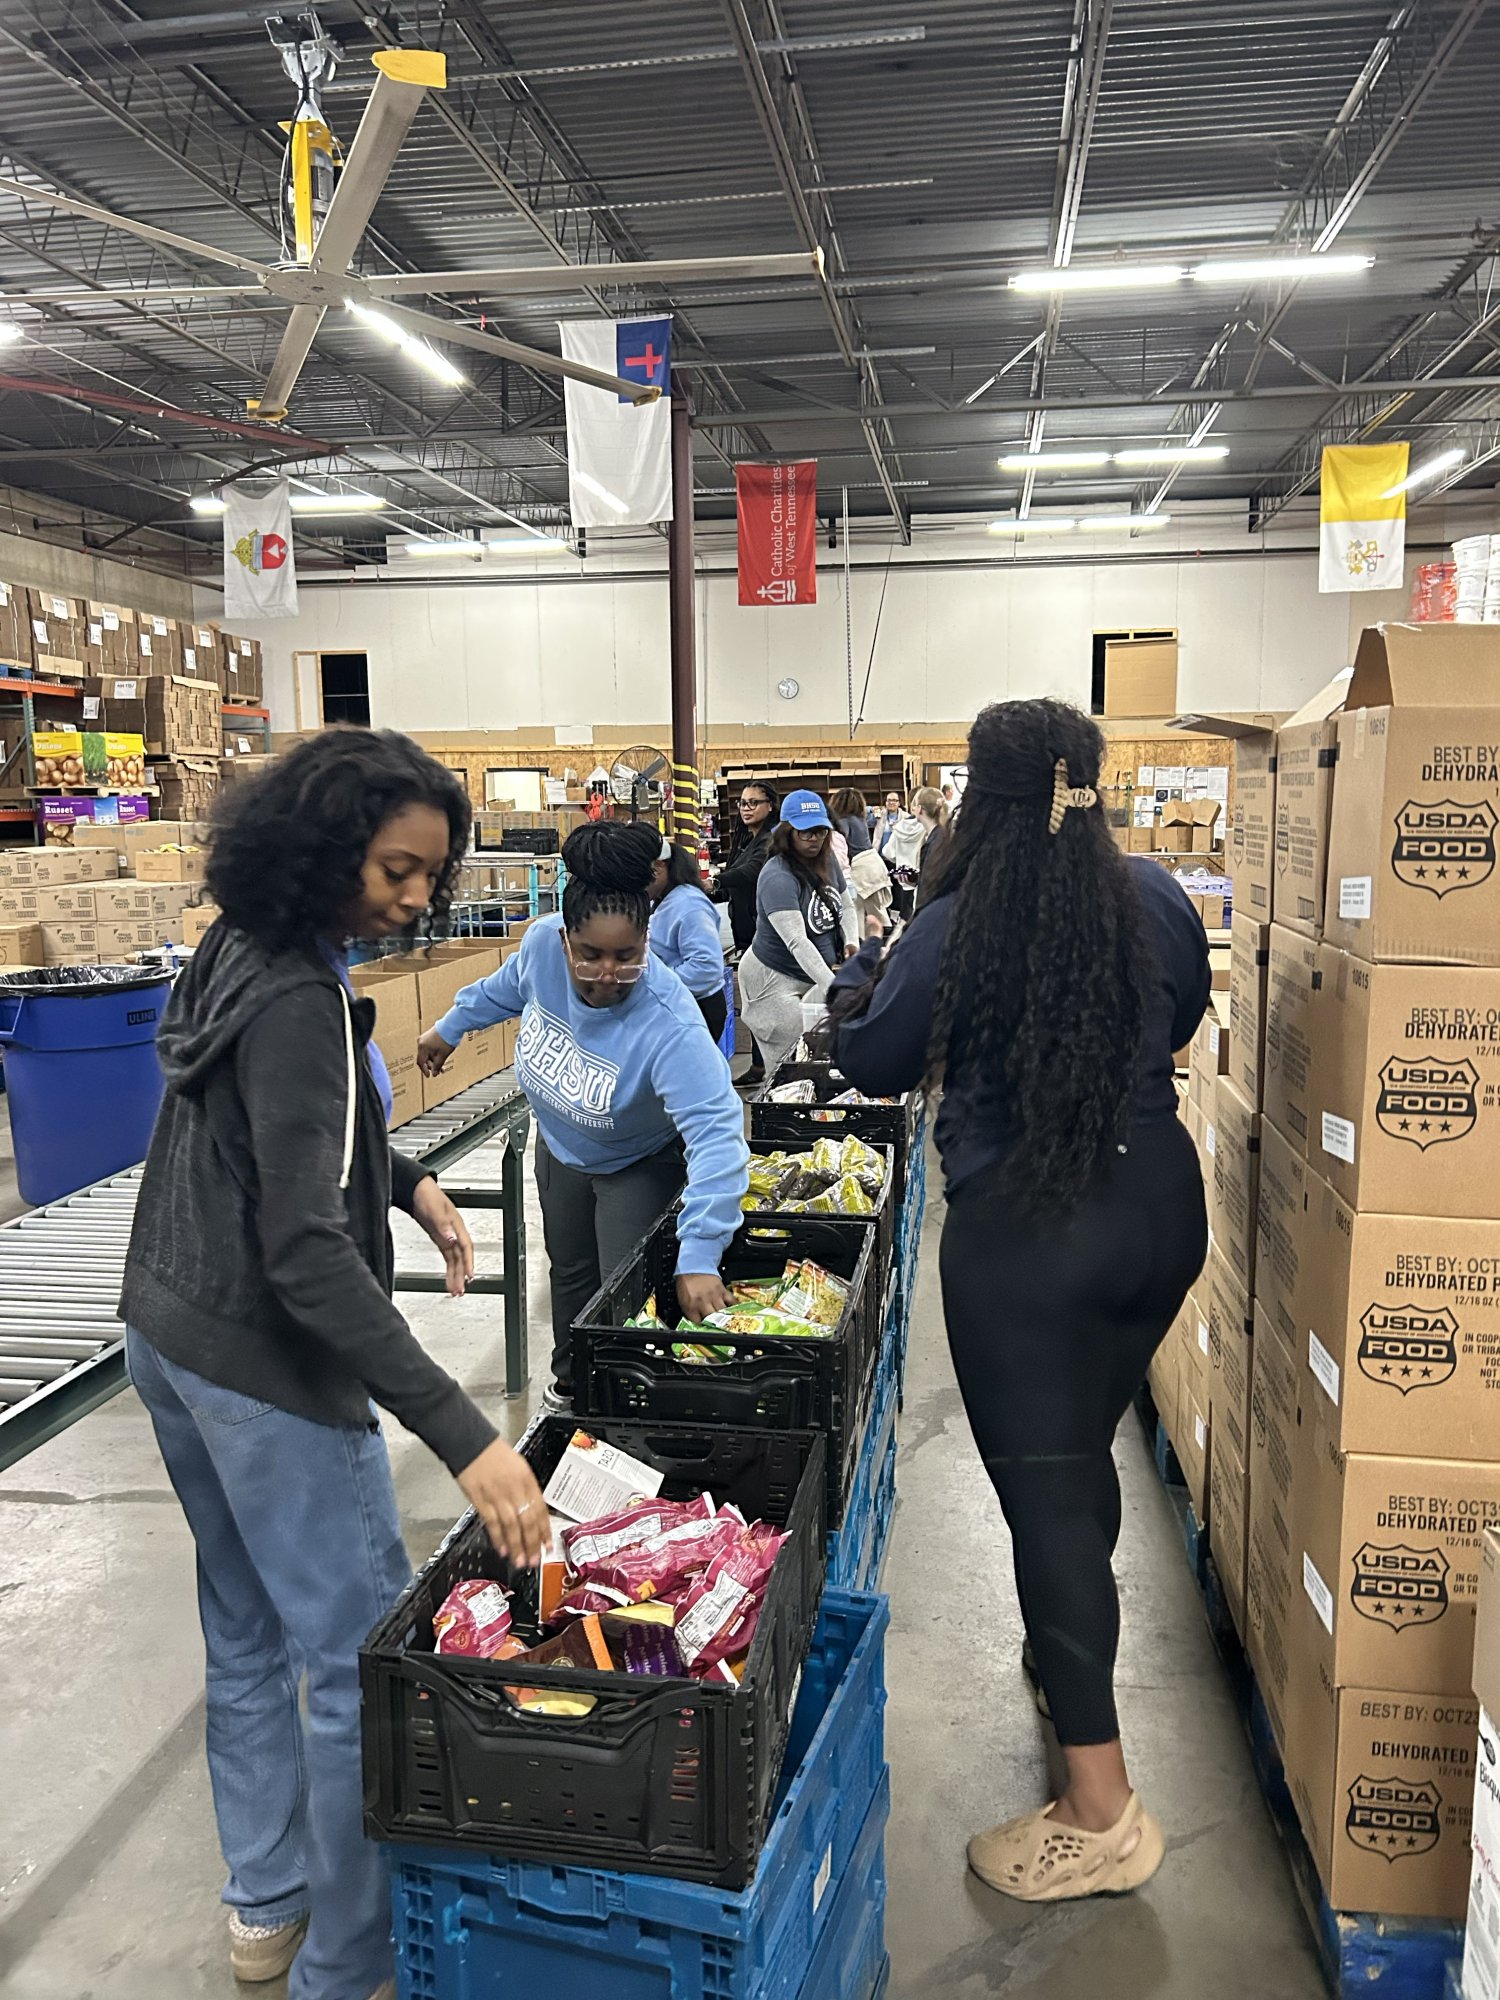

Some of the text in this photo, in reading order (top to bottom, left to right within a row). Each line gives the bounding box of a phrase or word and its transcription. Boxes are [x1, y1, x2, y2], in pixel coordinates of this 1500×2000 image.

[771, 466, 783, 577] Catholic Charities
[786, 466, 798, 576] of West Tennessee
[1434, 746, 1472, 764] BEST
[1422, 764, 1500, 781] DEHYDRA
[44, 805, 74, 814] Russet
[119, 805, 136, 813] Russet
[1404, 813, 1488, 828] USDA
[1402, 841, 1487, 857] FOOD
[1411, 1008, 1500, 1025] BEST BY: O
[1405, 1022, 1500, 1041] DEHYDRATE
[520, 1005, 616, 1116] BHSU
[1388, 1068, 1470, 1085] USDA
[1386, 1095, 1468, 1112] FOOD
[1483, 1096, 1494, 1106] OR
[571, 1112, 615, 1130] UNIVERSITY
[1396, 1254, 1432, 1271] BEST
[1436, 1257, 1462, 1273] BY:
[1385, 1271, 1487, 1291] DEHYDRATED
[1455, 1295, 1480, 1305] 12/16
[1369, 1314, 1449, 1333] USDA
[1465, 1333, 1500, 1344] IN COOP
[1367, 1340, 1448, 1359] FOOD
[1462, 1344, 1473, 1353] OR
[1480, 1368, 1497, 1378] NOT
[1389, 1495, 1500, 1517] BEST BY: OCT3
[1377, 1512, 1477, 1534] DEHYDRATED
[1446, 1537, 1471, 1548] 12/16
[1361, 1553, 1440, 1573] USDA
[1456, 1573, 1465, 1583] IN
[1360, 1579, 1440, 1598] FOOD
[1453, 1584, 1465, 1593] OR
[1360, 1702, 1401, 1719] BEST
[1404, 1705, 1429, 1721] BY:
[1371, 1741, 1469, 1764] DEHYDRATED
[1356, 1786, 1433, 1805] USDA
[1355, 1810, 1432, 1830] FOOD
